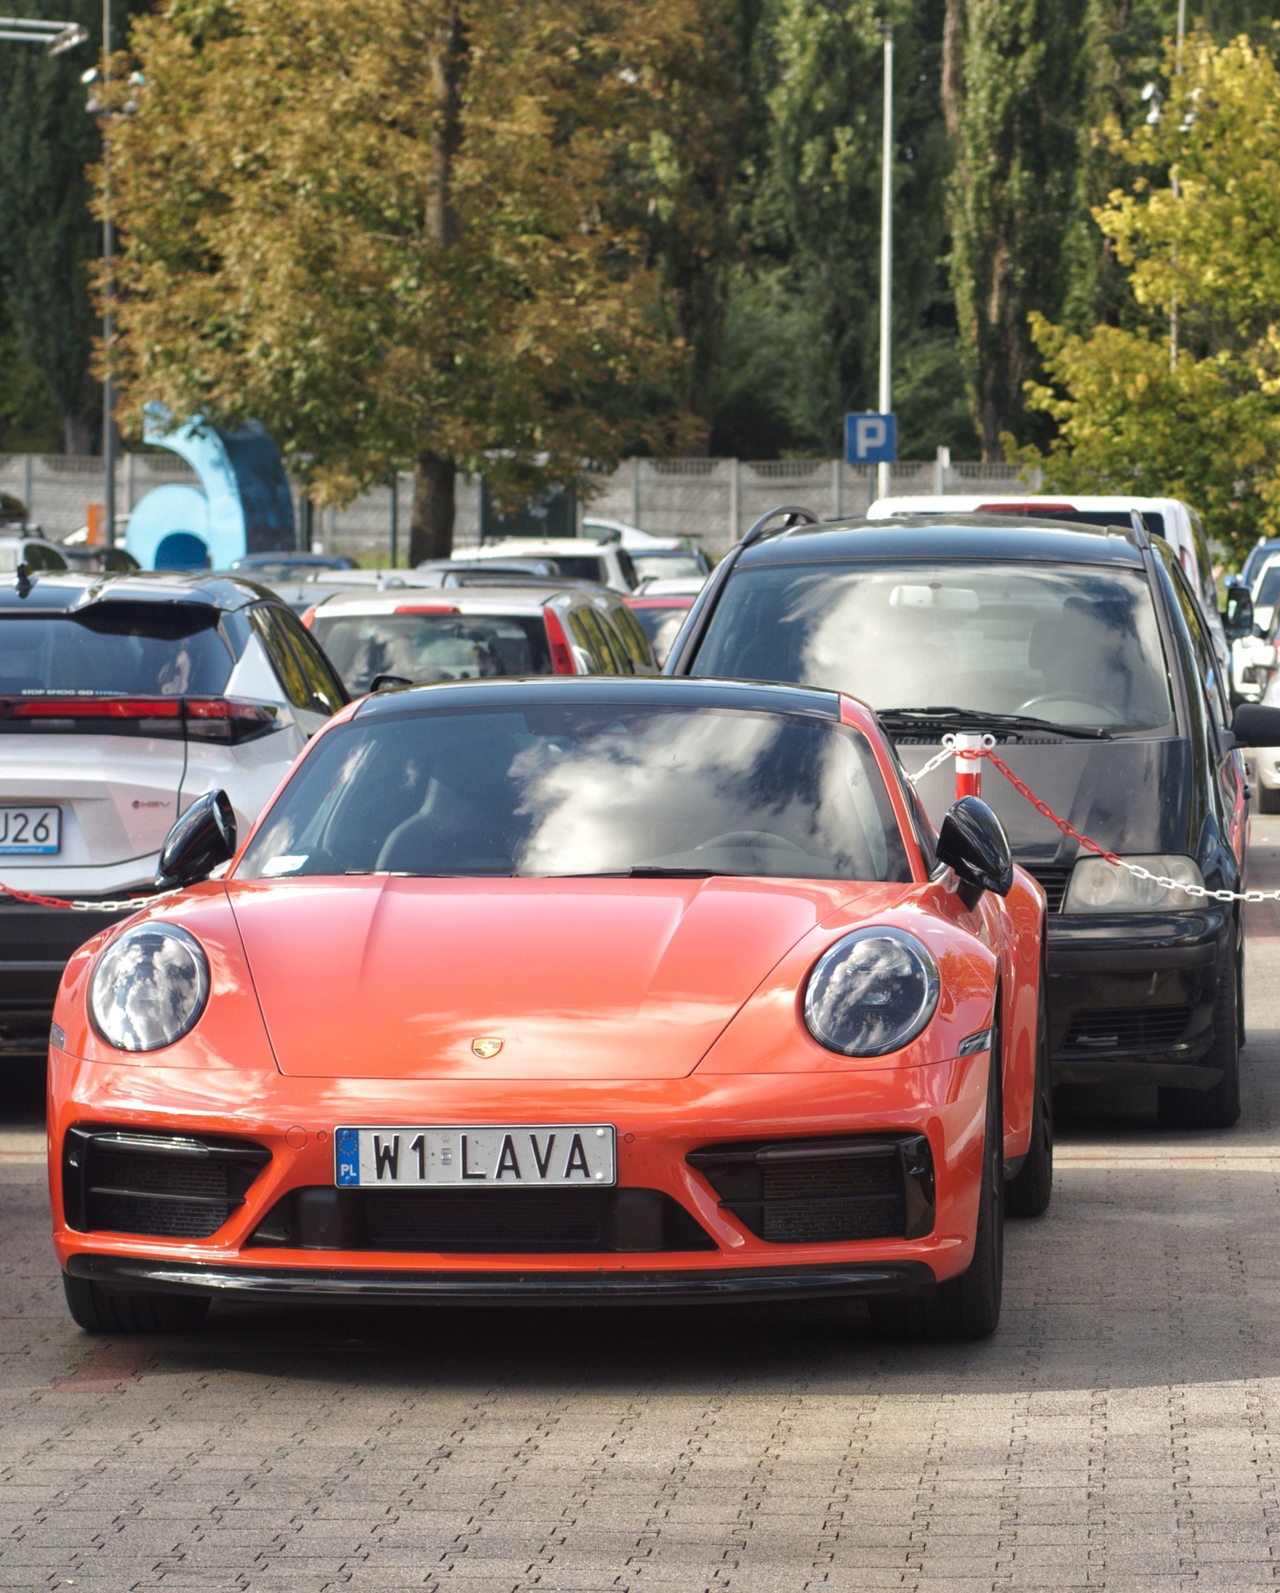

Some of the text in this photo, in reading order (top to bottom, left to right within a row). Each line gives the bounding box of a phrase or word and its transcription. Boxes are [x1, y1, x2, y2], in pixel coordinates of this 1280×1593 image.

[857, 418, 886, 458] P
[21, 688, 45, 696] STOP
[46, 688, 76, 696] SMOG
[372, 1133, 591, 1180] W1 LAVA
[340, 1164, 357, 1177] PL
